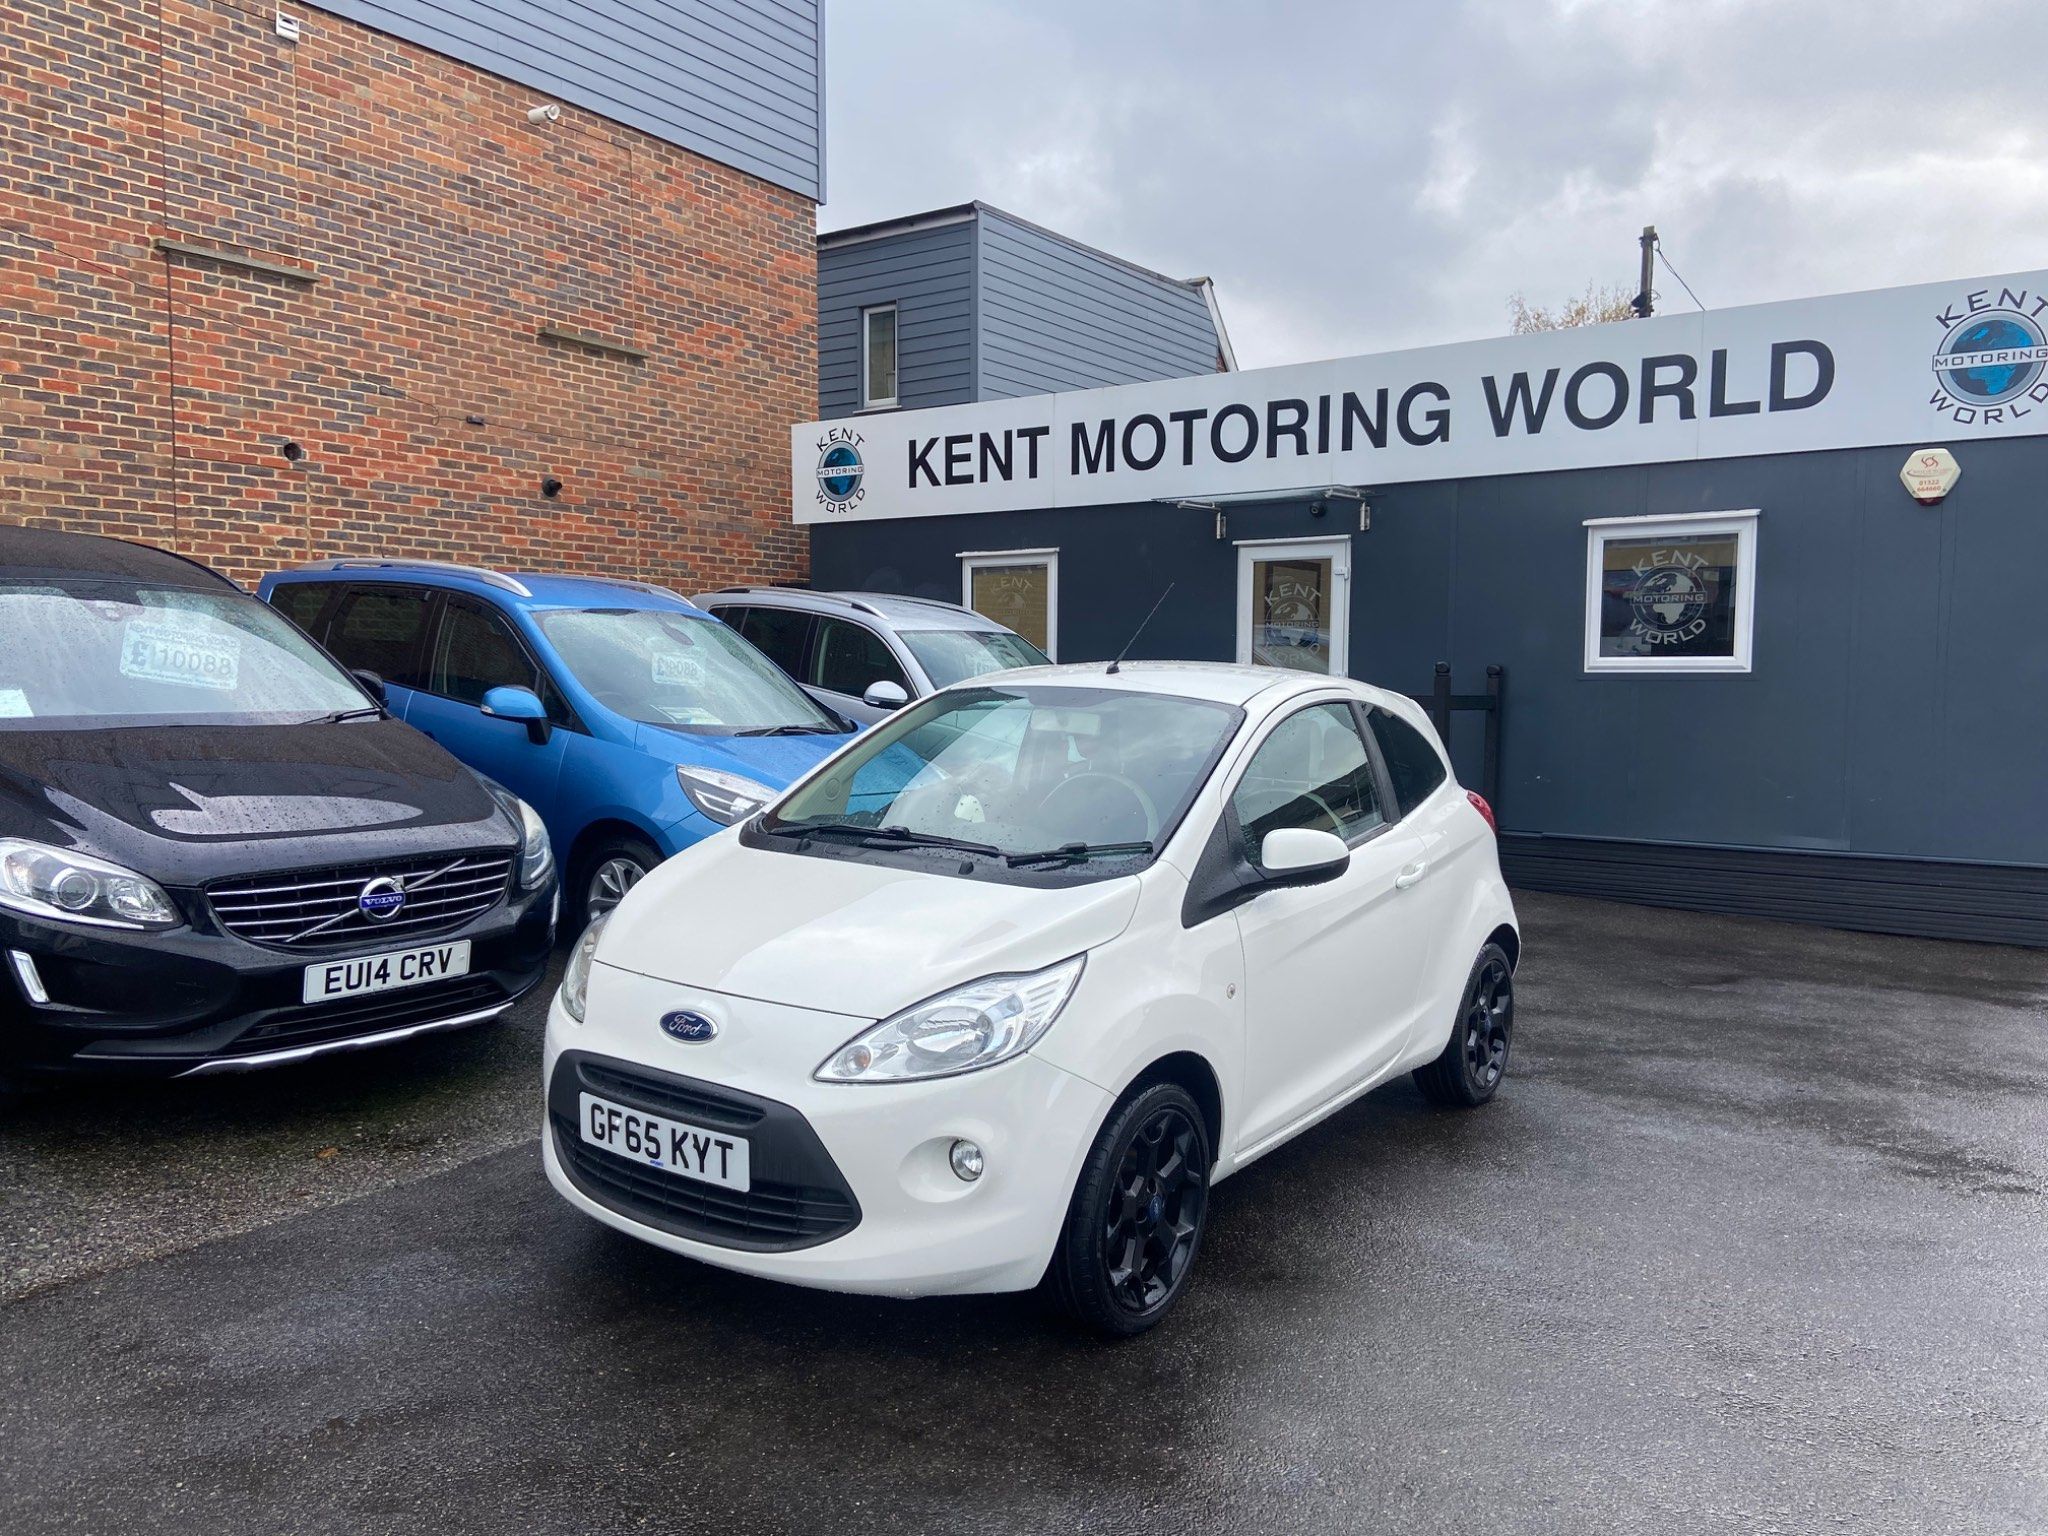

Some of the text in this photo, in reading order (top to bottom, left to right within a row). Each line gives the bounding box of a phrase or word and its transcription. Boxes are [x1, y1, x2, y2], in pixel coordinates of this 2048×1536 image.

[1936, 288, 2048, 329] KENT
[1934, 348, 2048, 368] MOTORING
[908, 339, 1835, 489] KENT MOTORING WORLD
[1929, 382, 2048, 425] WORLD
[816, 427, 865, 452] KENT
[816, 466, 865, 476] MOTORING
[816, 488, 866, 513] WORLD
[1631, 549, 1709, 577] KENT
[1264, 582, 1321, 606] KENT
[1632, 593, 1705, 604] MOTORING
[1629, 618, 1707, 645] WORLD
[364, 895, 403, 906] VOLVO
[324, 947, 453, 995] EU14 CRV
[668, 1014, 703, 1036] Ford
[590, 1103, 734, 1180] GF65 KYT
